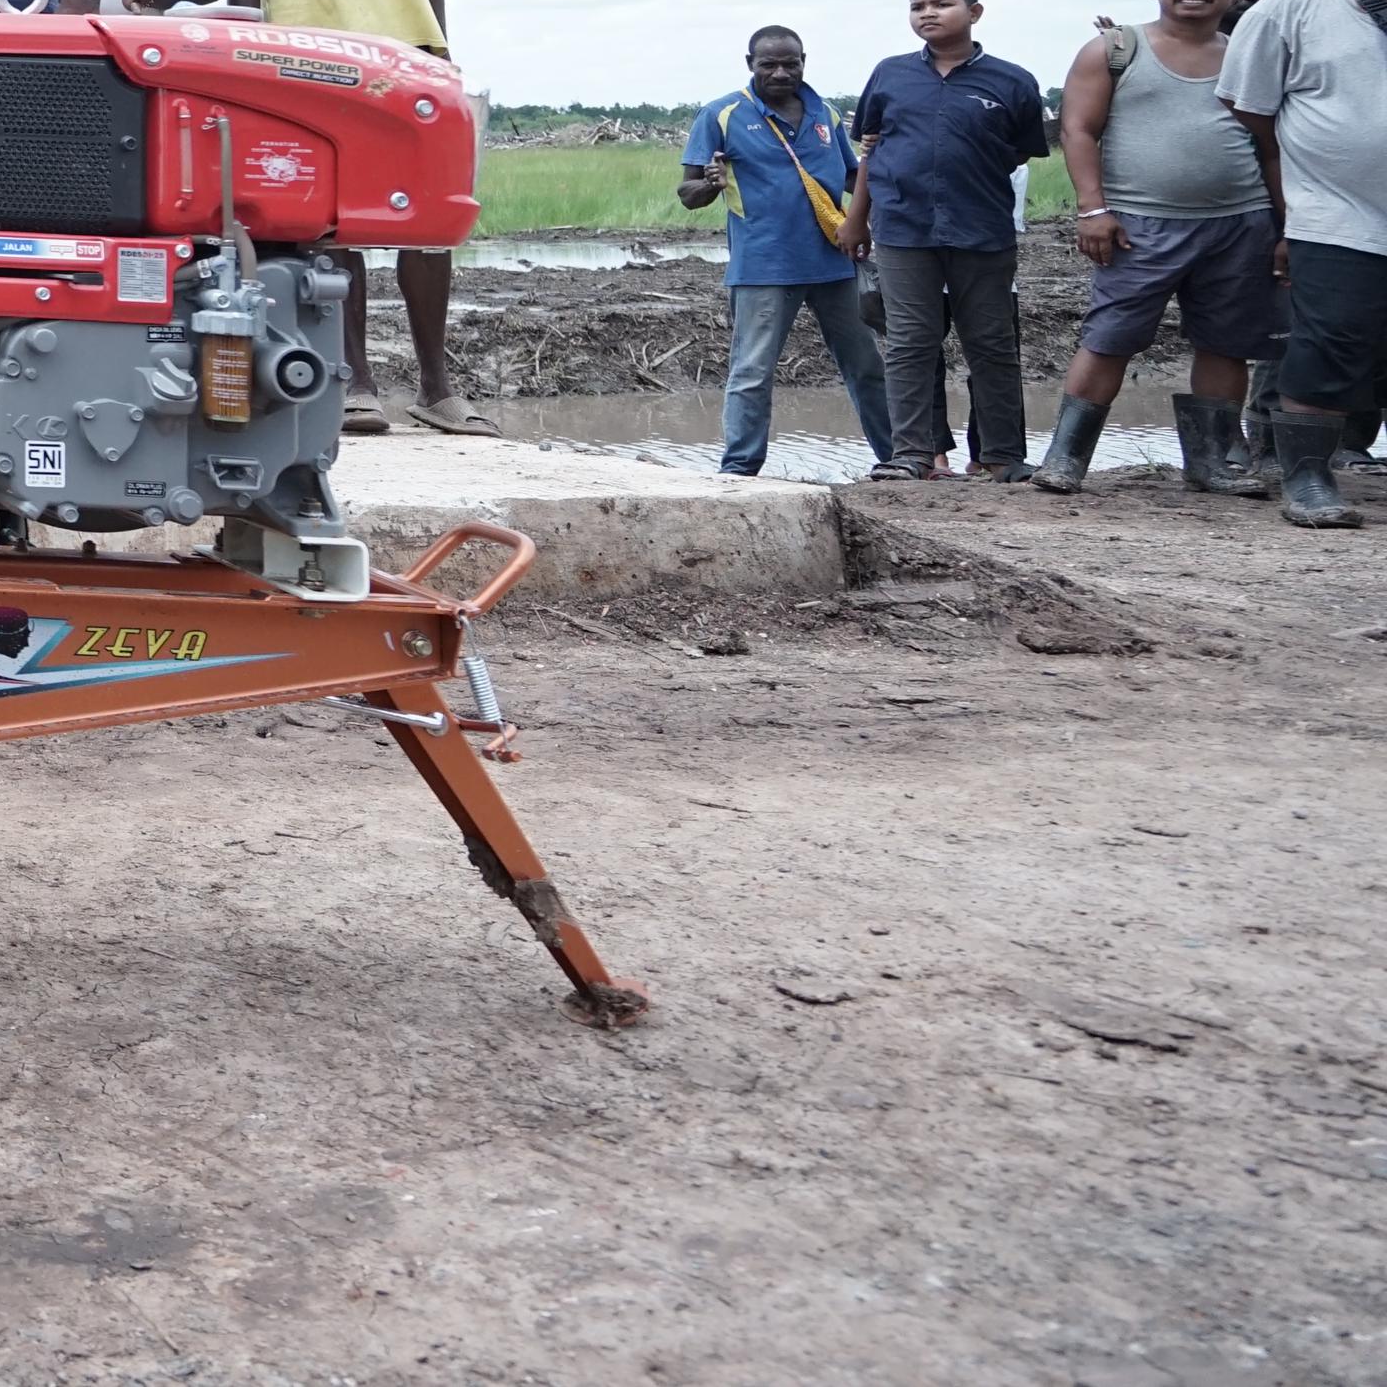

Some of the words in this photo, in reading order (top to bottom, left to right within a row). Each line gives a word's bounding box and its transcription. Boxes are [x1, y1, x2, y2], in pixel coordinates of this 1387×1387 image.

[236, 50, 295, 68] SUPER
[299, 59, 359, 76] POWER
[281, 68, 312, 79] DIRECT
[2, 243, 33, 253] JALAN
[76, 245, 101, 256] STOP
[28, 449, 62, 470] SNI
[76, 626, 208, 661] ZEVA
